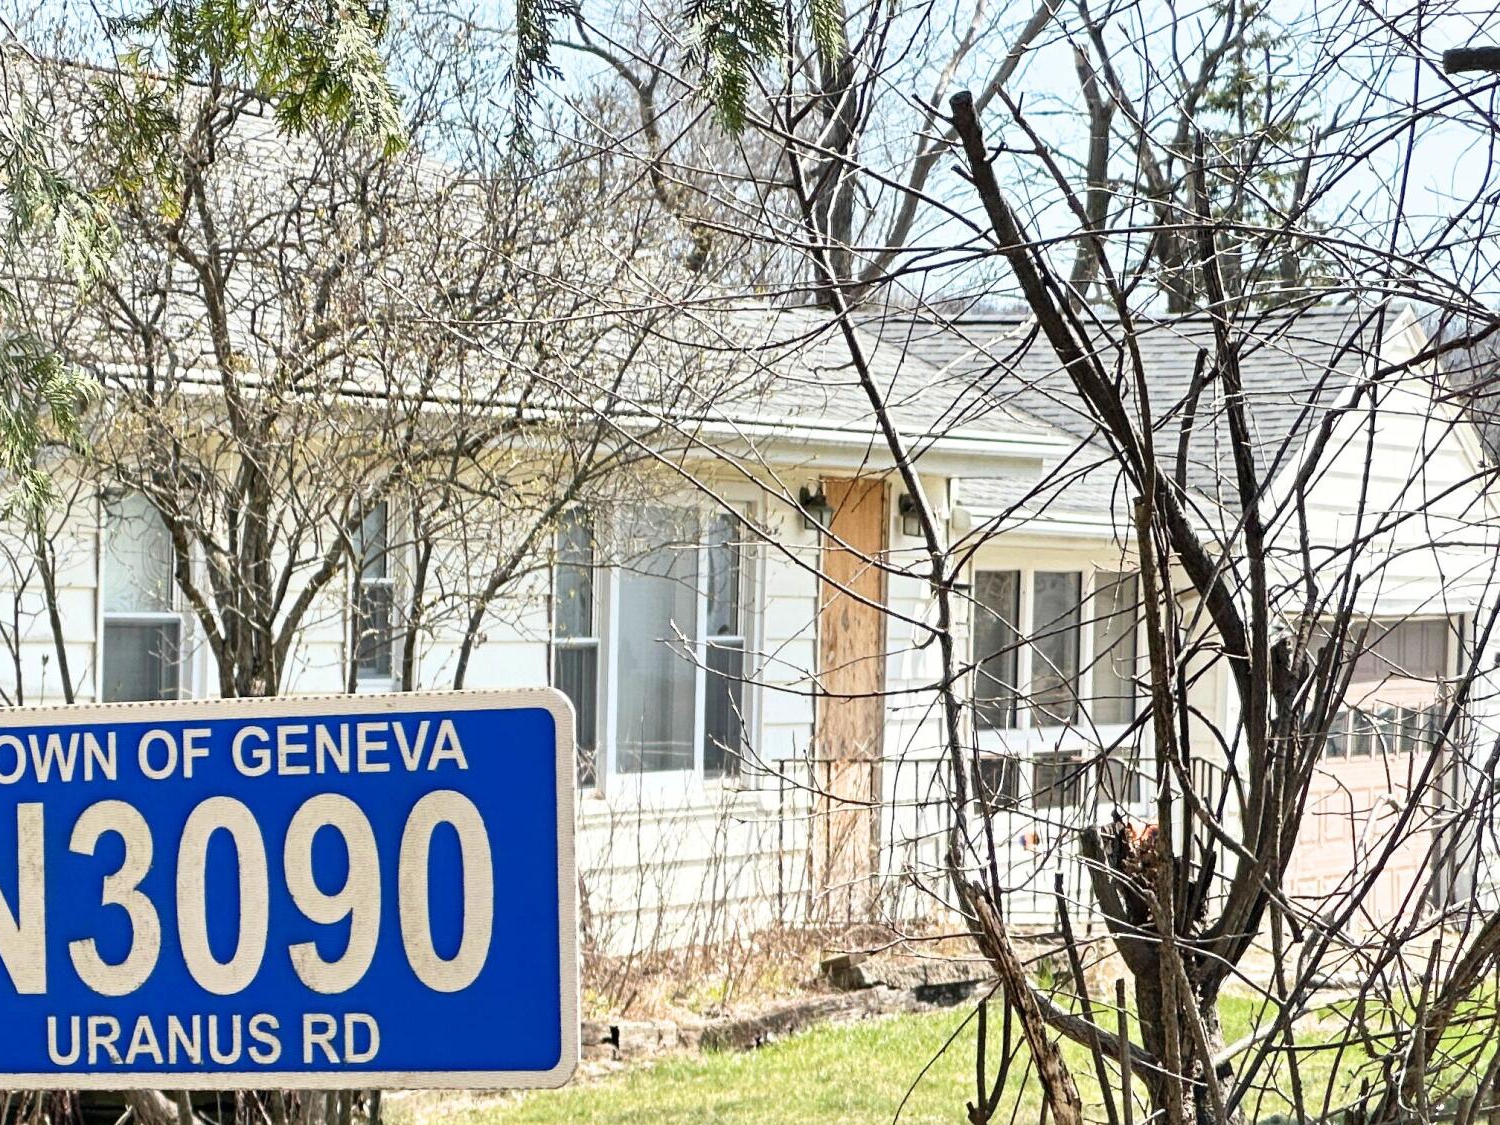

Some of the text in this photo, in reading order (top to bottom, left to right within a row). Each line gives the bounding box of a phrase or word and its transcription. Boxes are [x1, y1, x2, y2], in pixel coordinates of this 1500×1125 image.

[139, 728, 212, 780] OF
[232, 719, 469, 777] GENEVA
[47, 1012, 380, 1066] URANUS RD
